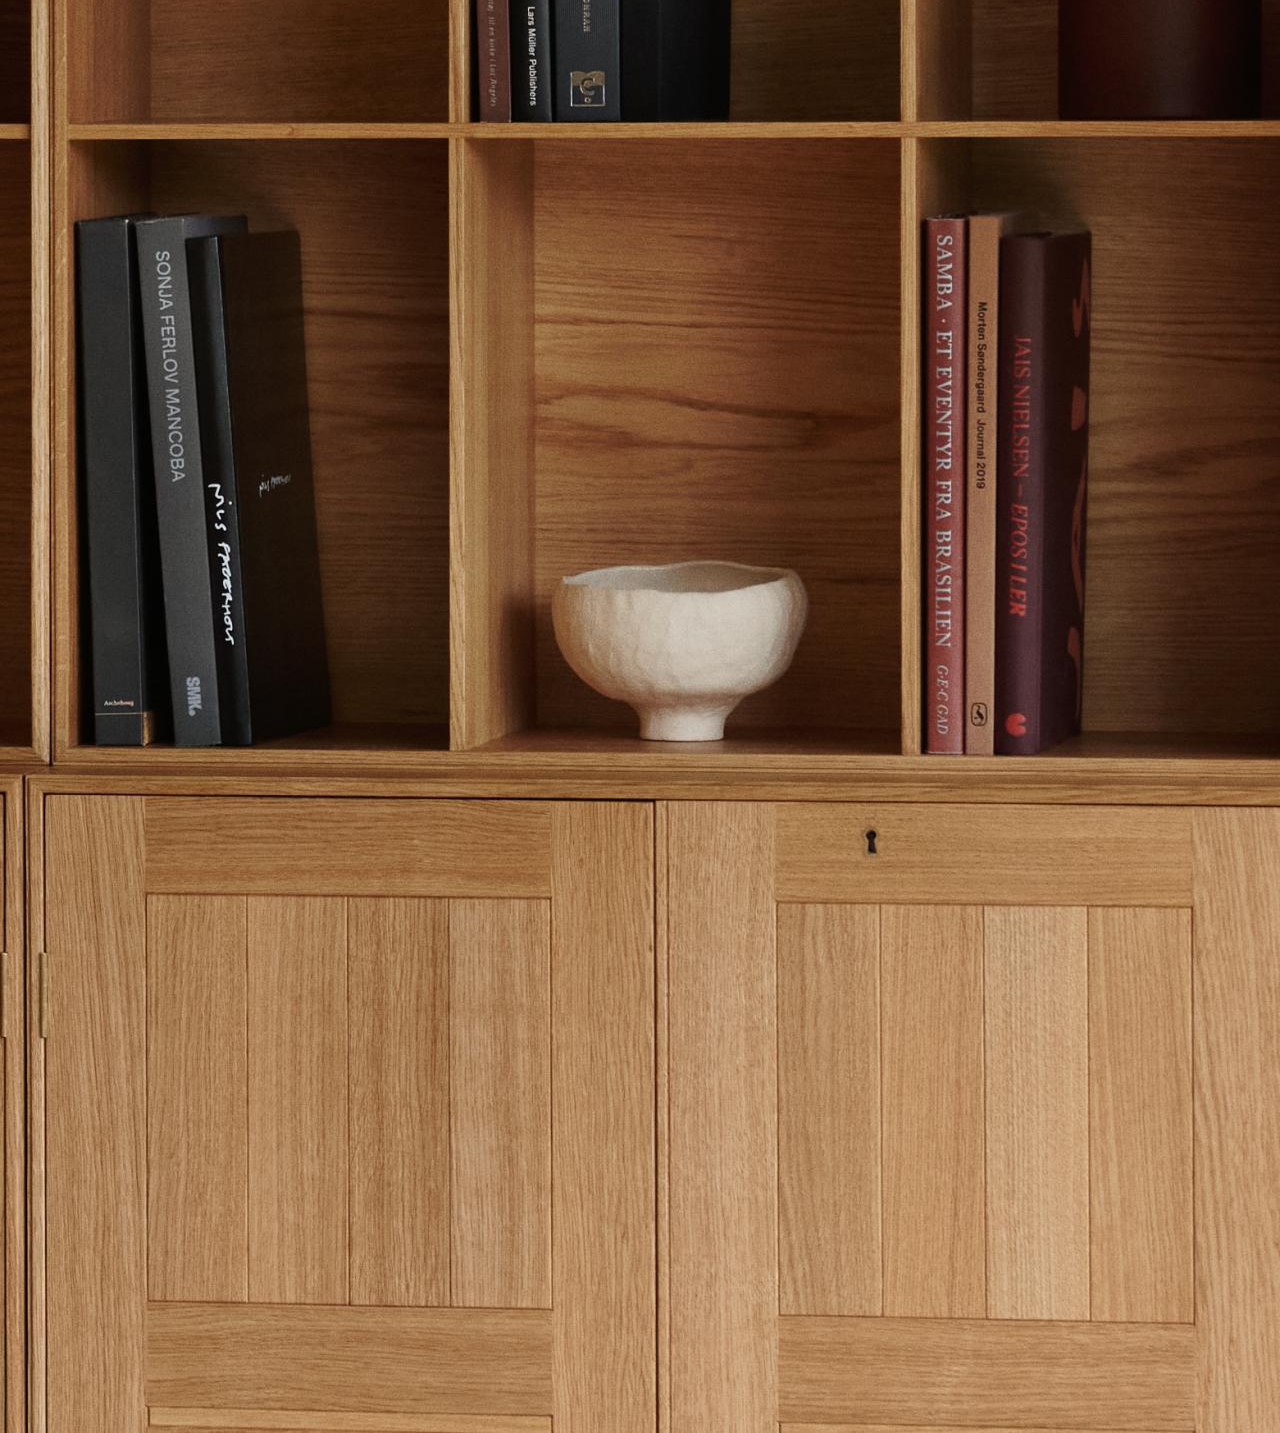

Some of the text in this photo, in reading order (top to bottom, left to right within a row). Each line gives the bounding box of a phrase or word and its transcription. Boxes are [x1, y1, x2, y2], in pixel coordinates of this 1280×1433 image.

[527, 6, 537, 106] Lars Müller Publishers
[155, 251, 172, 311] SONJA
[936, 234, 953, 311] SAMBA
[160, 315, 178, 384] FERLOV
[936, 330, 953, 360] ET
[936, 366, 953, 471] EVENTYR
[975, 301, 988, 489] Morten Søndergaard Journal 2019
[165, 388, 186, 483] MANCOBA
[1011, 385, 1031, 478] NIELSEN
[936, 480, 952, 522] FRA
[1009, 503, 1028, 559] EPOS
[936, 530, 952, 648] BRASILIEN
[1009, 563, 1028, 572] I
[1009, 574, 1028, 617] LER
[936, 704, 949, 735] GAD
